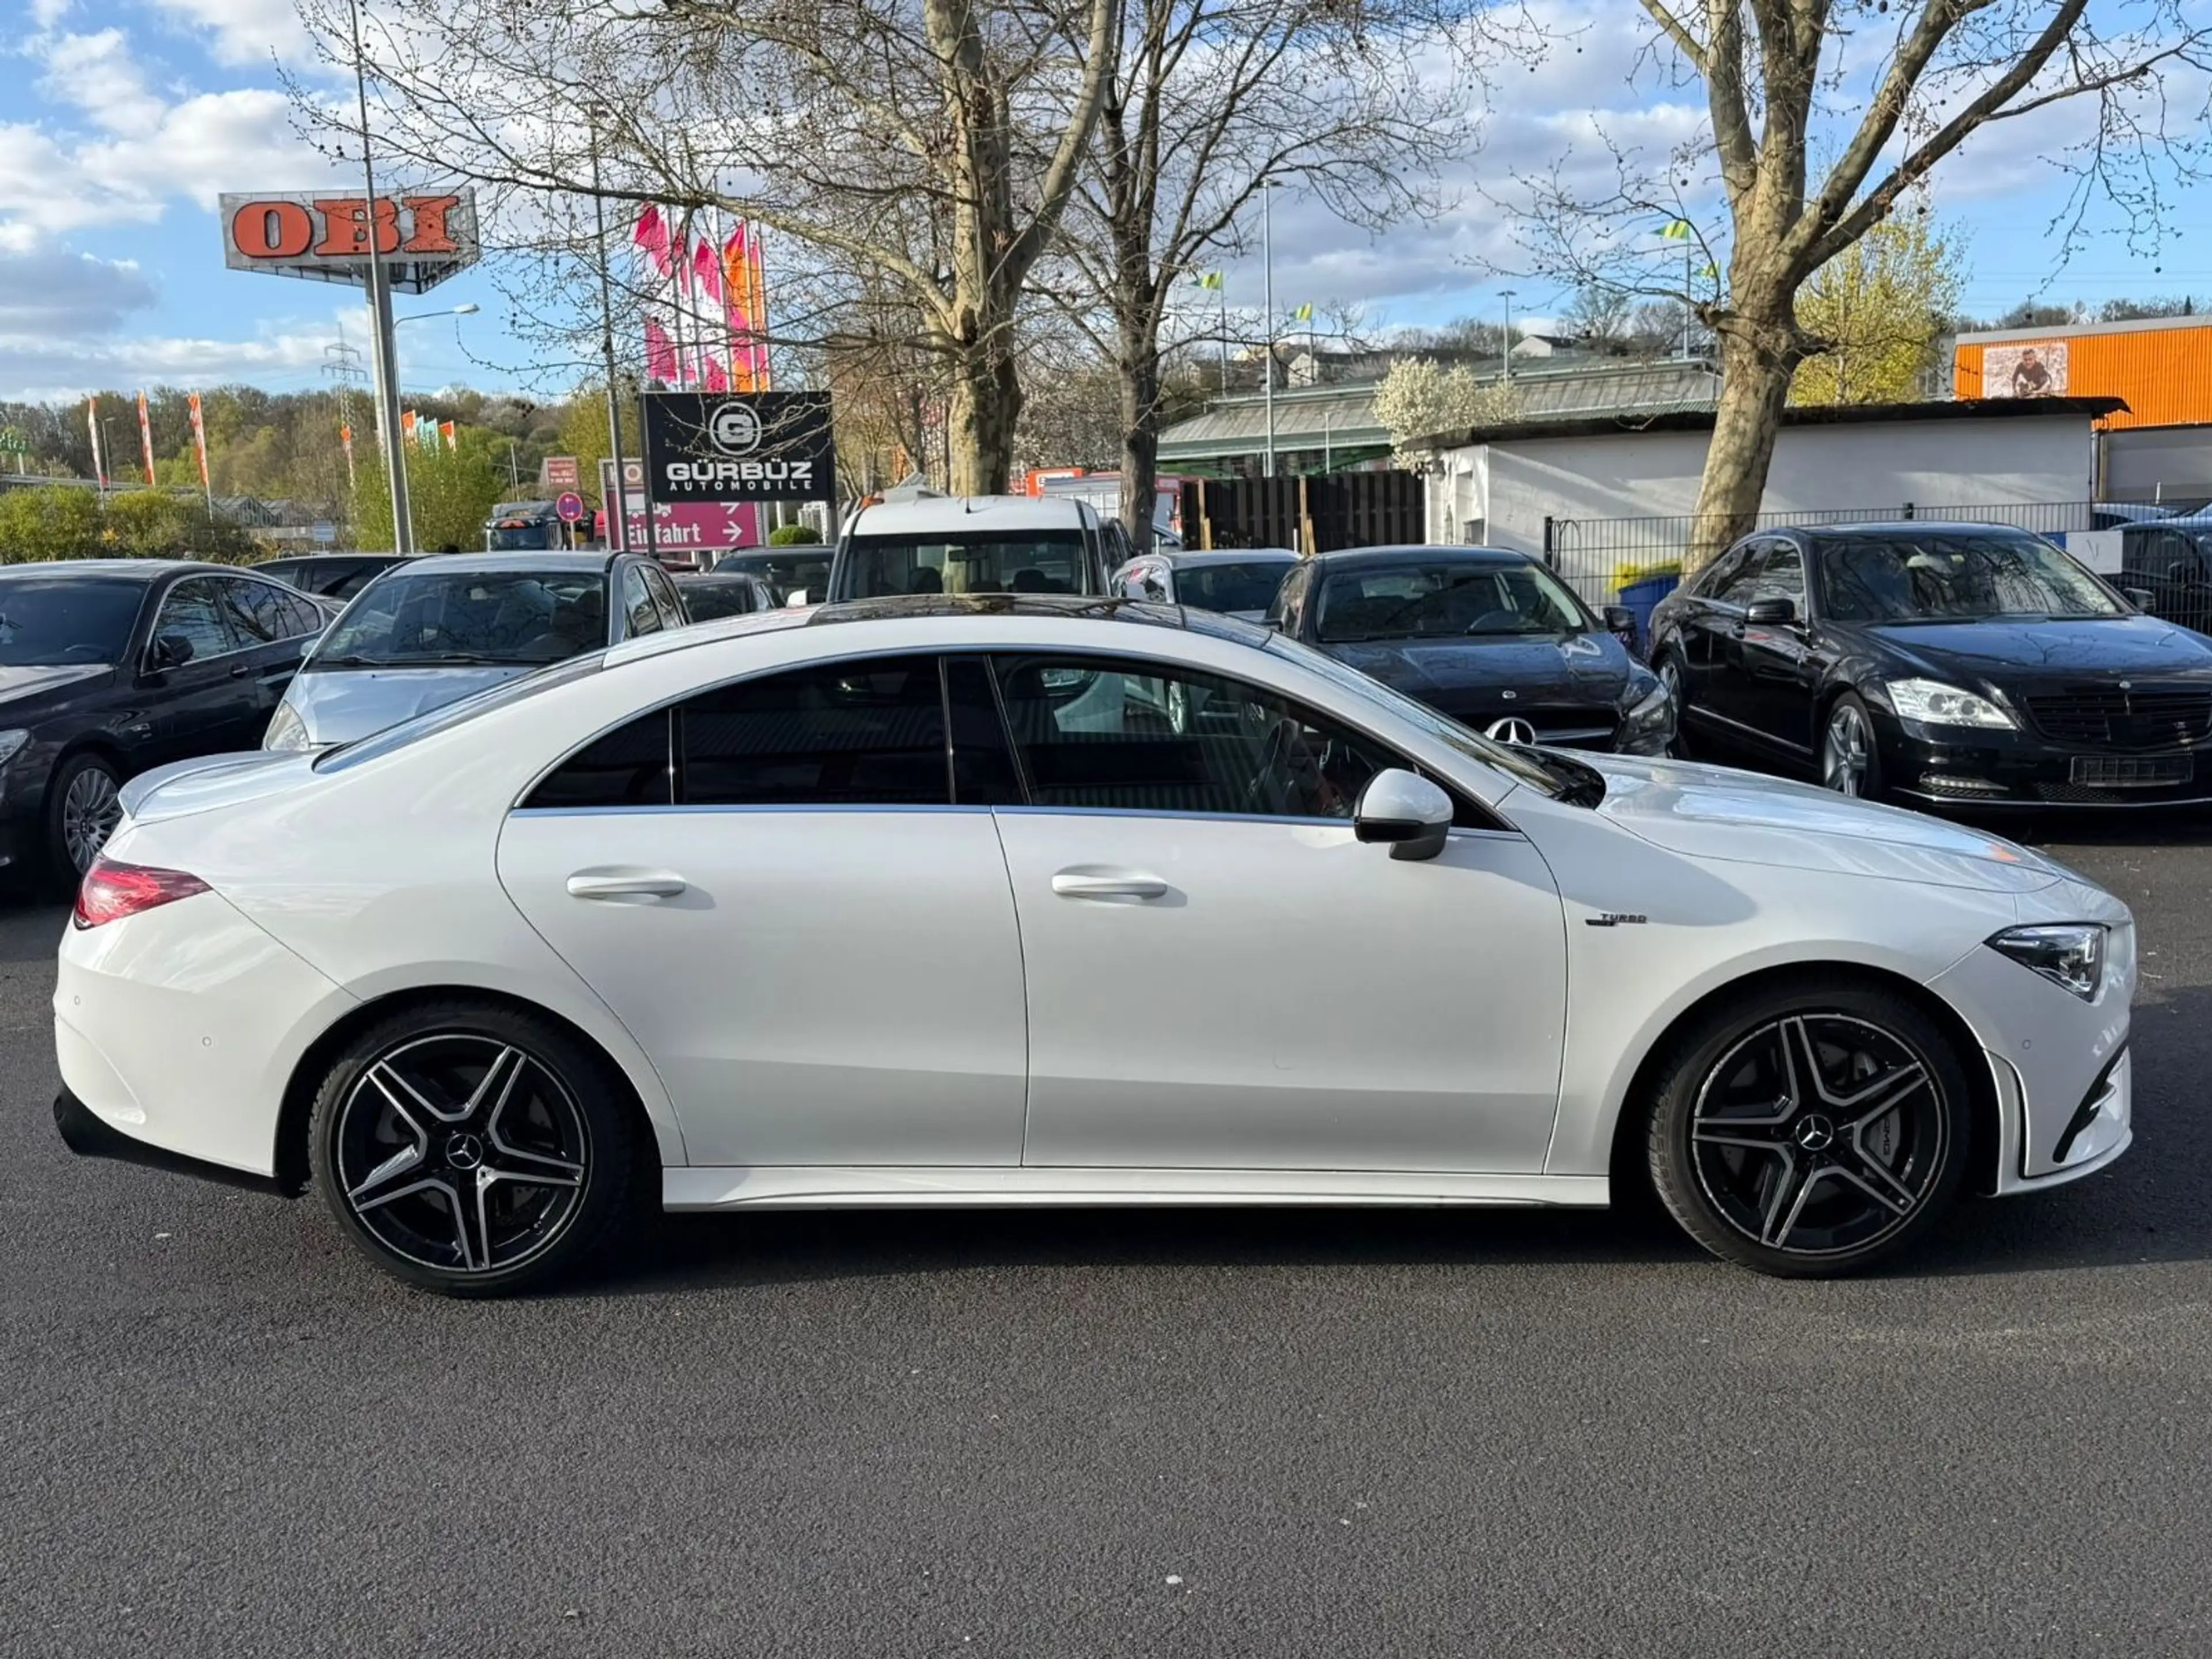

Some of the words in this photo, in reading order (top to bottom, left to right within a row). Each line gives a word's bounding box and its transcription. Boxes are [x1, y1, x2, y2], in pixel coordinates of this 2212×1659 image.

[232, 196, 460, 257] OBI
[666, 459, 813, 480] GÜRBÜZ
[670, 480, 812, 490] AUTOMOBILE
[1601, 914, 1647, 923] TURBO
